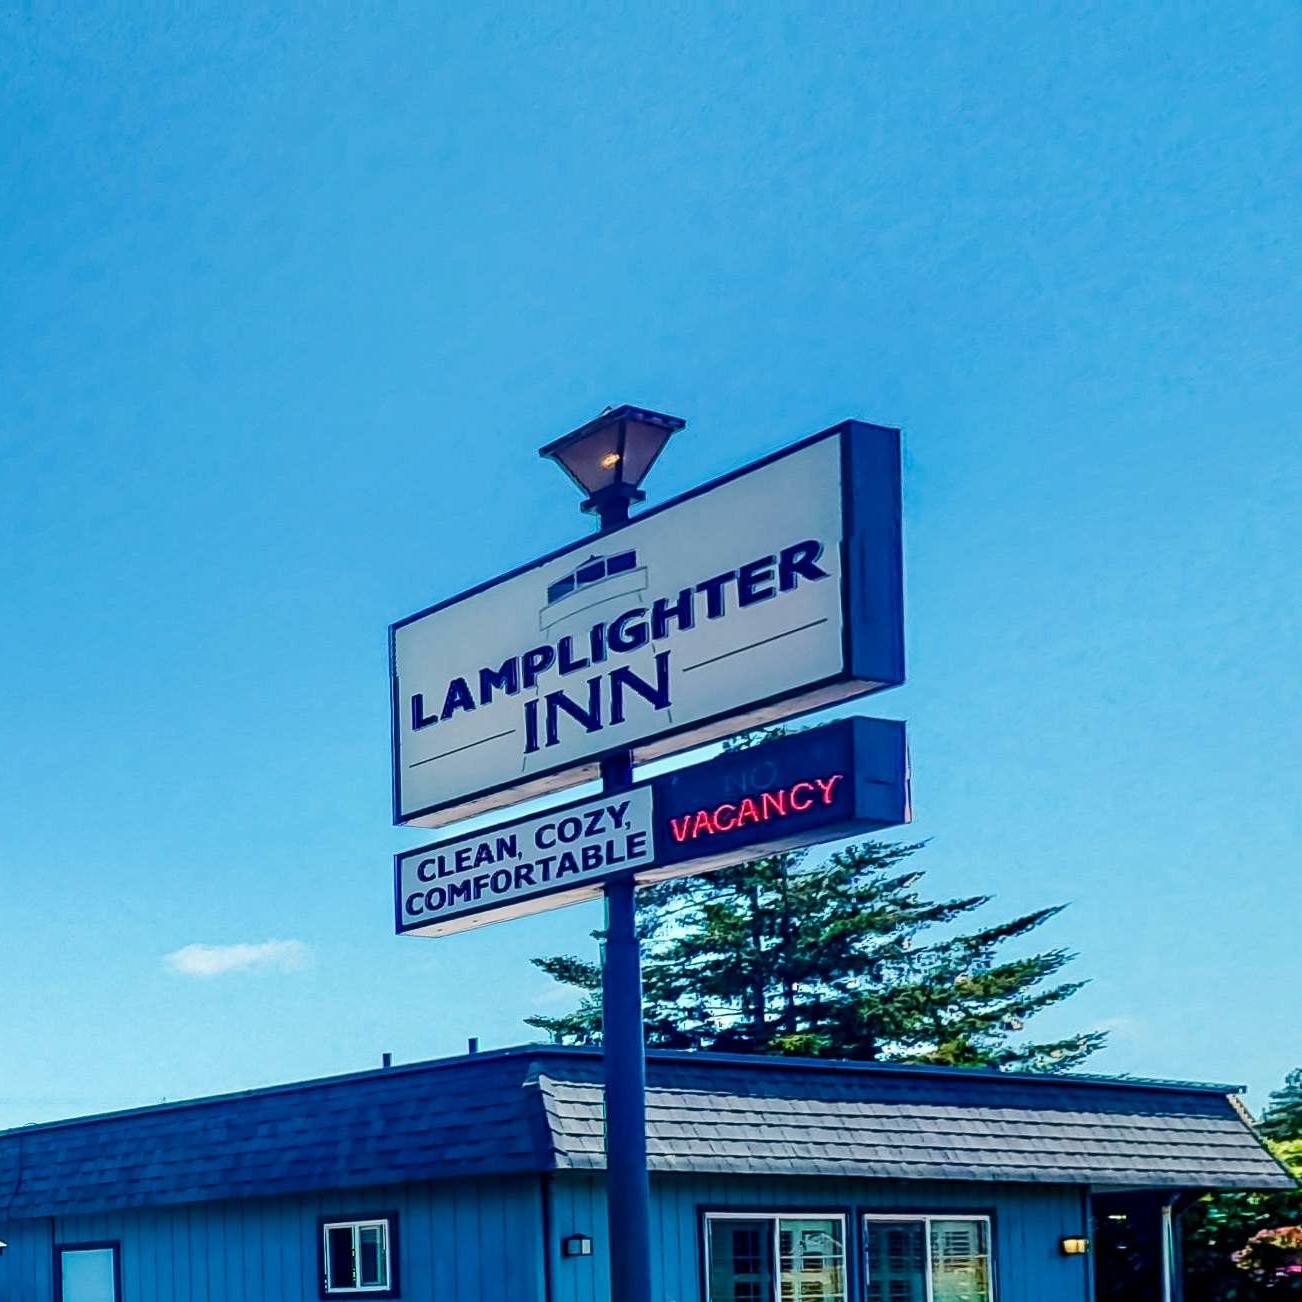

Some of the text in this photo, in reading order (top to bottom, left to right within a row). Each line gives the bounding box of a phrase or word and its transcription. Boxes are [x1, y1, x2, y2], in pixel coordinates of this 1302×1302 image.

[410, 539, 831, 731] LAMPLIGHTER
[523, 650, 672, 755] INN
[669, 774, 844, 843] VACANCY
[723, 760, 778, 796] NO
[404, 831, 647, 916] COMFORTABLE
[416, 800, 632, 883] CLEAN, COZY,
